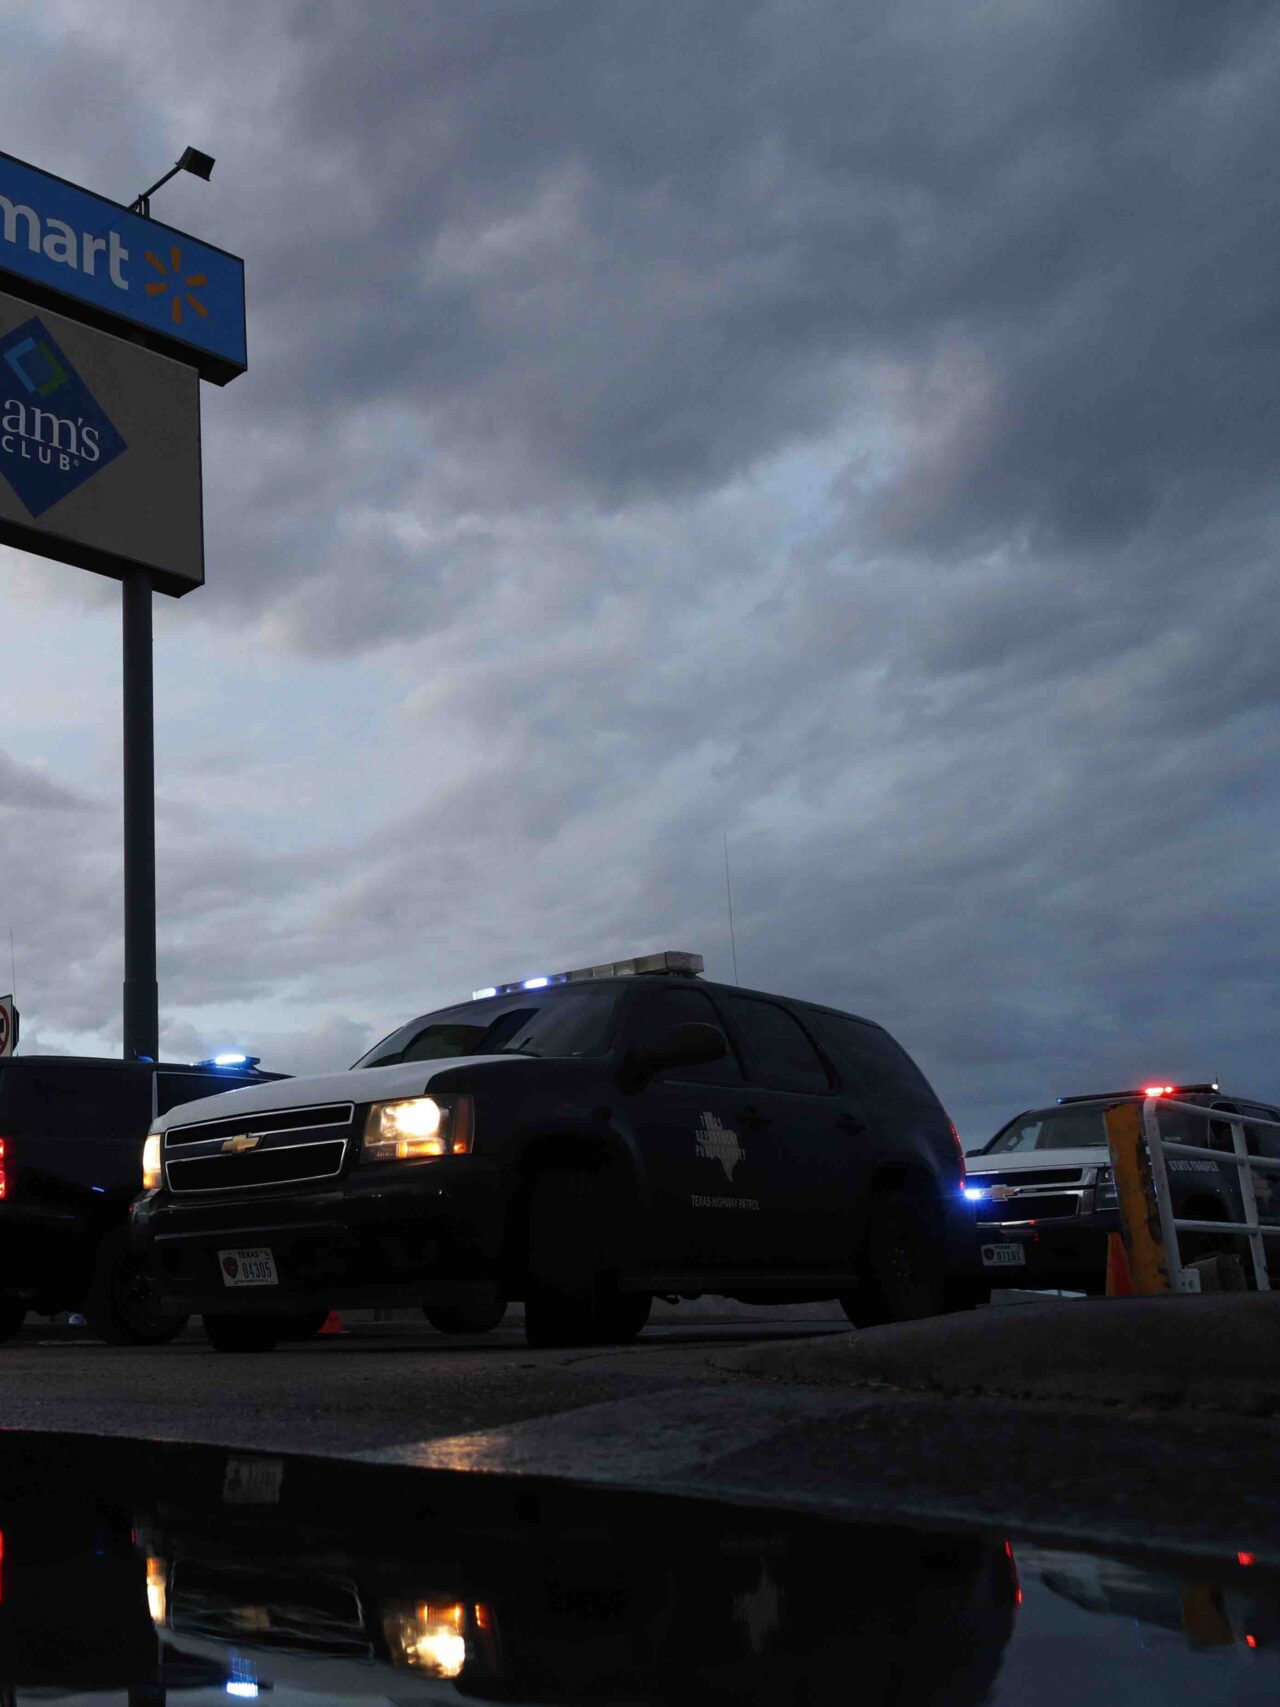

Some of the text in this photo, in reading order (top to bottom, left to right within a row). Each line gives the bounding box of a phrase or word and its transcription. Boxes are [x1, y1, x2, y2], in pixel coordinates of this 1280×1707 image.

[1, 435, 70, 471] CLUB
[691, 1194, 760, 1211] TEXAS HIGHWAY PATROL
[238, 1251, 259, 1259] TEXAS
[242, 1262, 272, 1279] 04305
